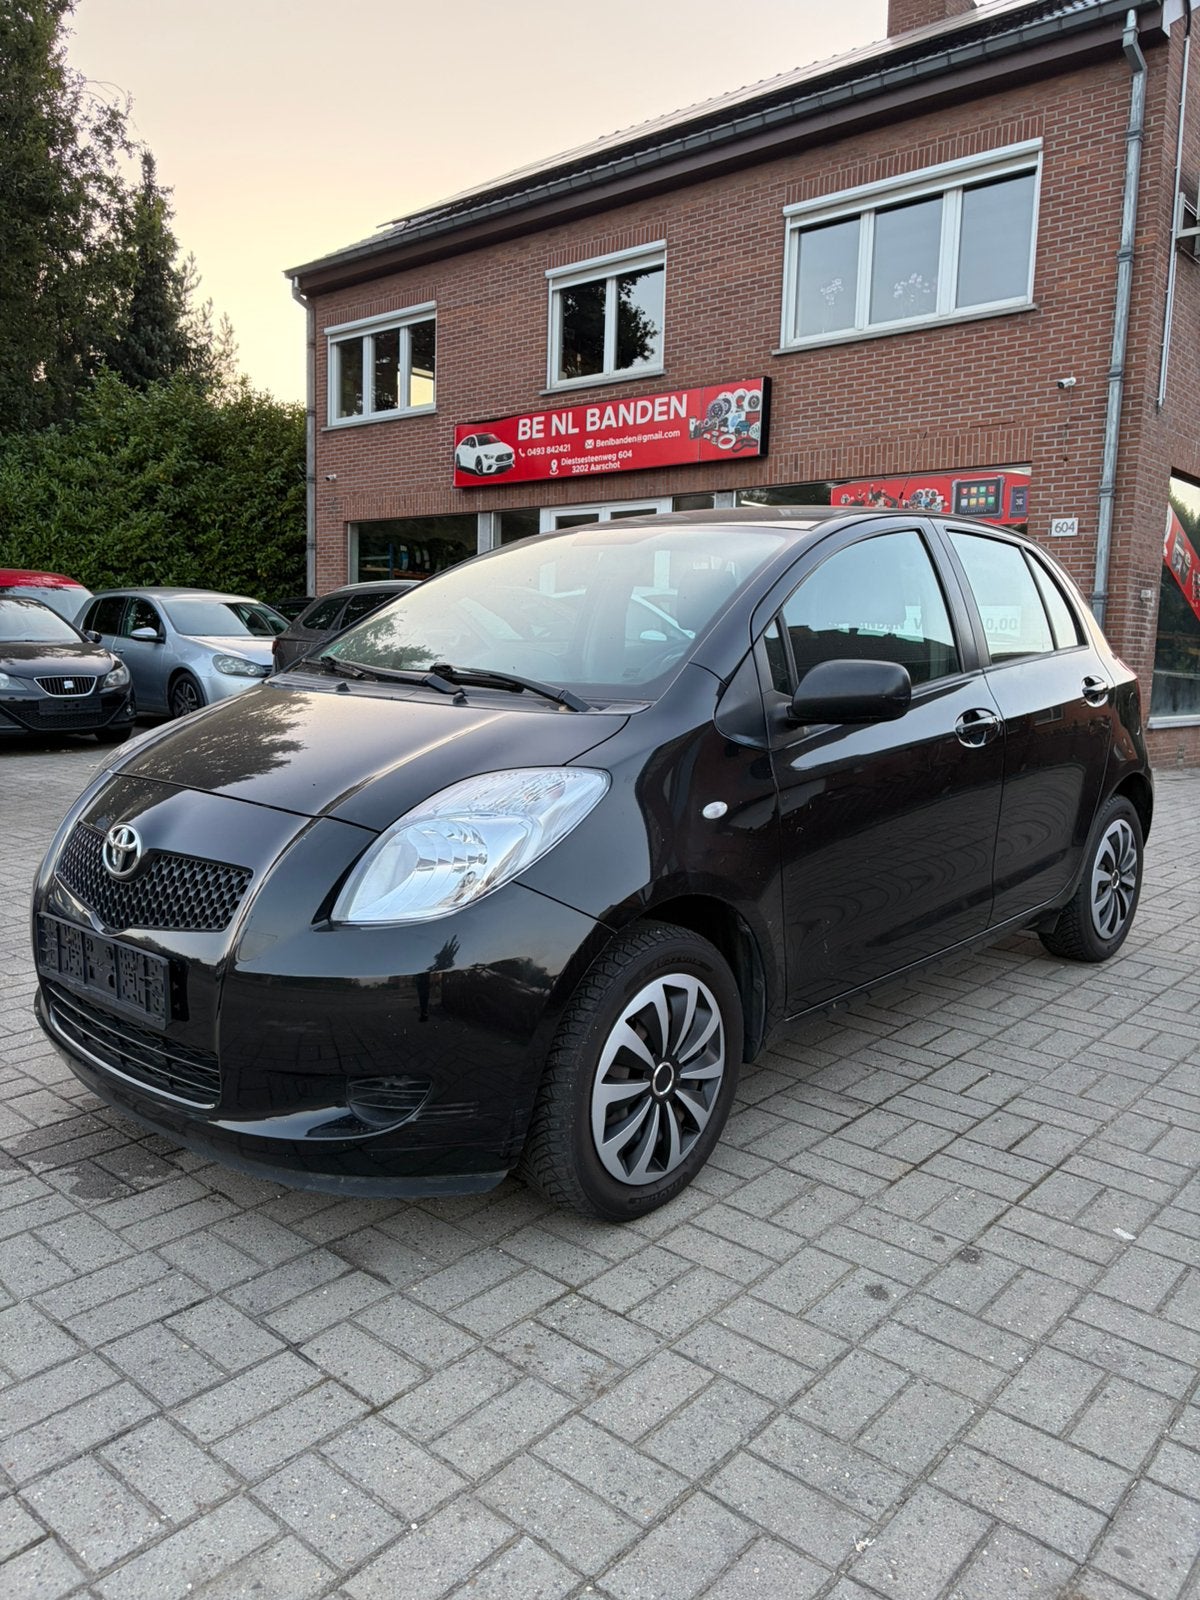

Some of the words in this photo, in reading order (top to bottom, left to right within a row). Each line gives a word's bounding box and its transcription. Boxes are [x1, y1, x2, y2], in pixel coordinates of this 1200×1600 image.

[518, 416, 545, 440] BE
[551, 412, 579, 436] NL
[586, 394, 688, 432] BANDEN
[595, 430, 681, 448] Benlbanden@gmail.com
[526, 446, 545, 457] 0493
[546, 443, 571, 454] 842421
[560, 453, 617, 466] Diestsesteenweg
[617, 449, 633, 459] 604
[571, 464, 589, 474] 3202
[590, 460, 620, 471] Aarschot
[1055, 521, 1076, 534] 604
